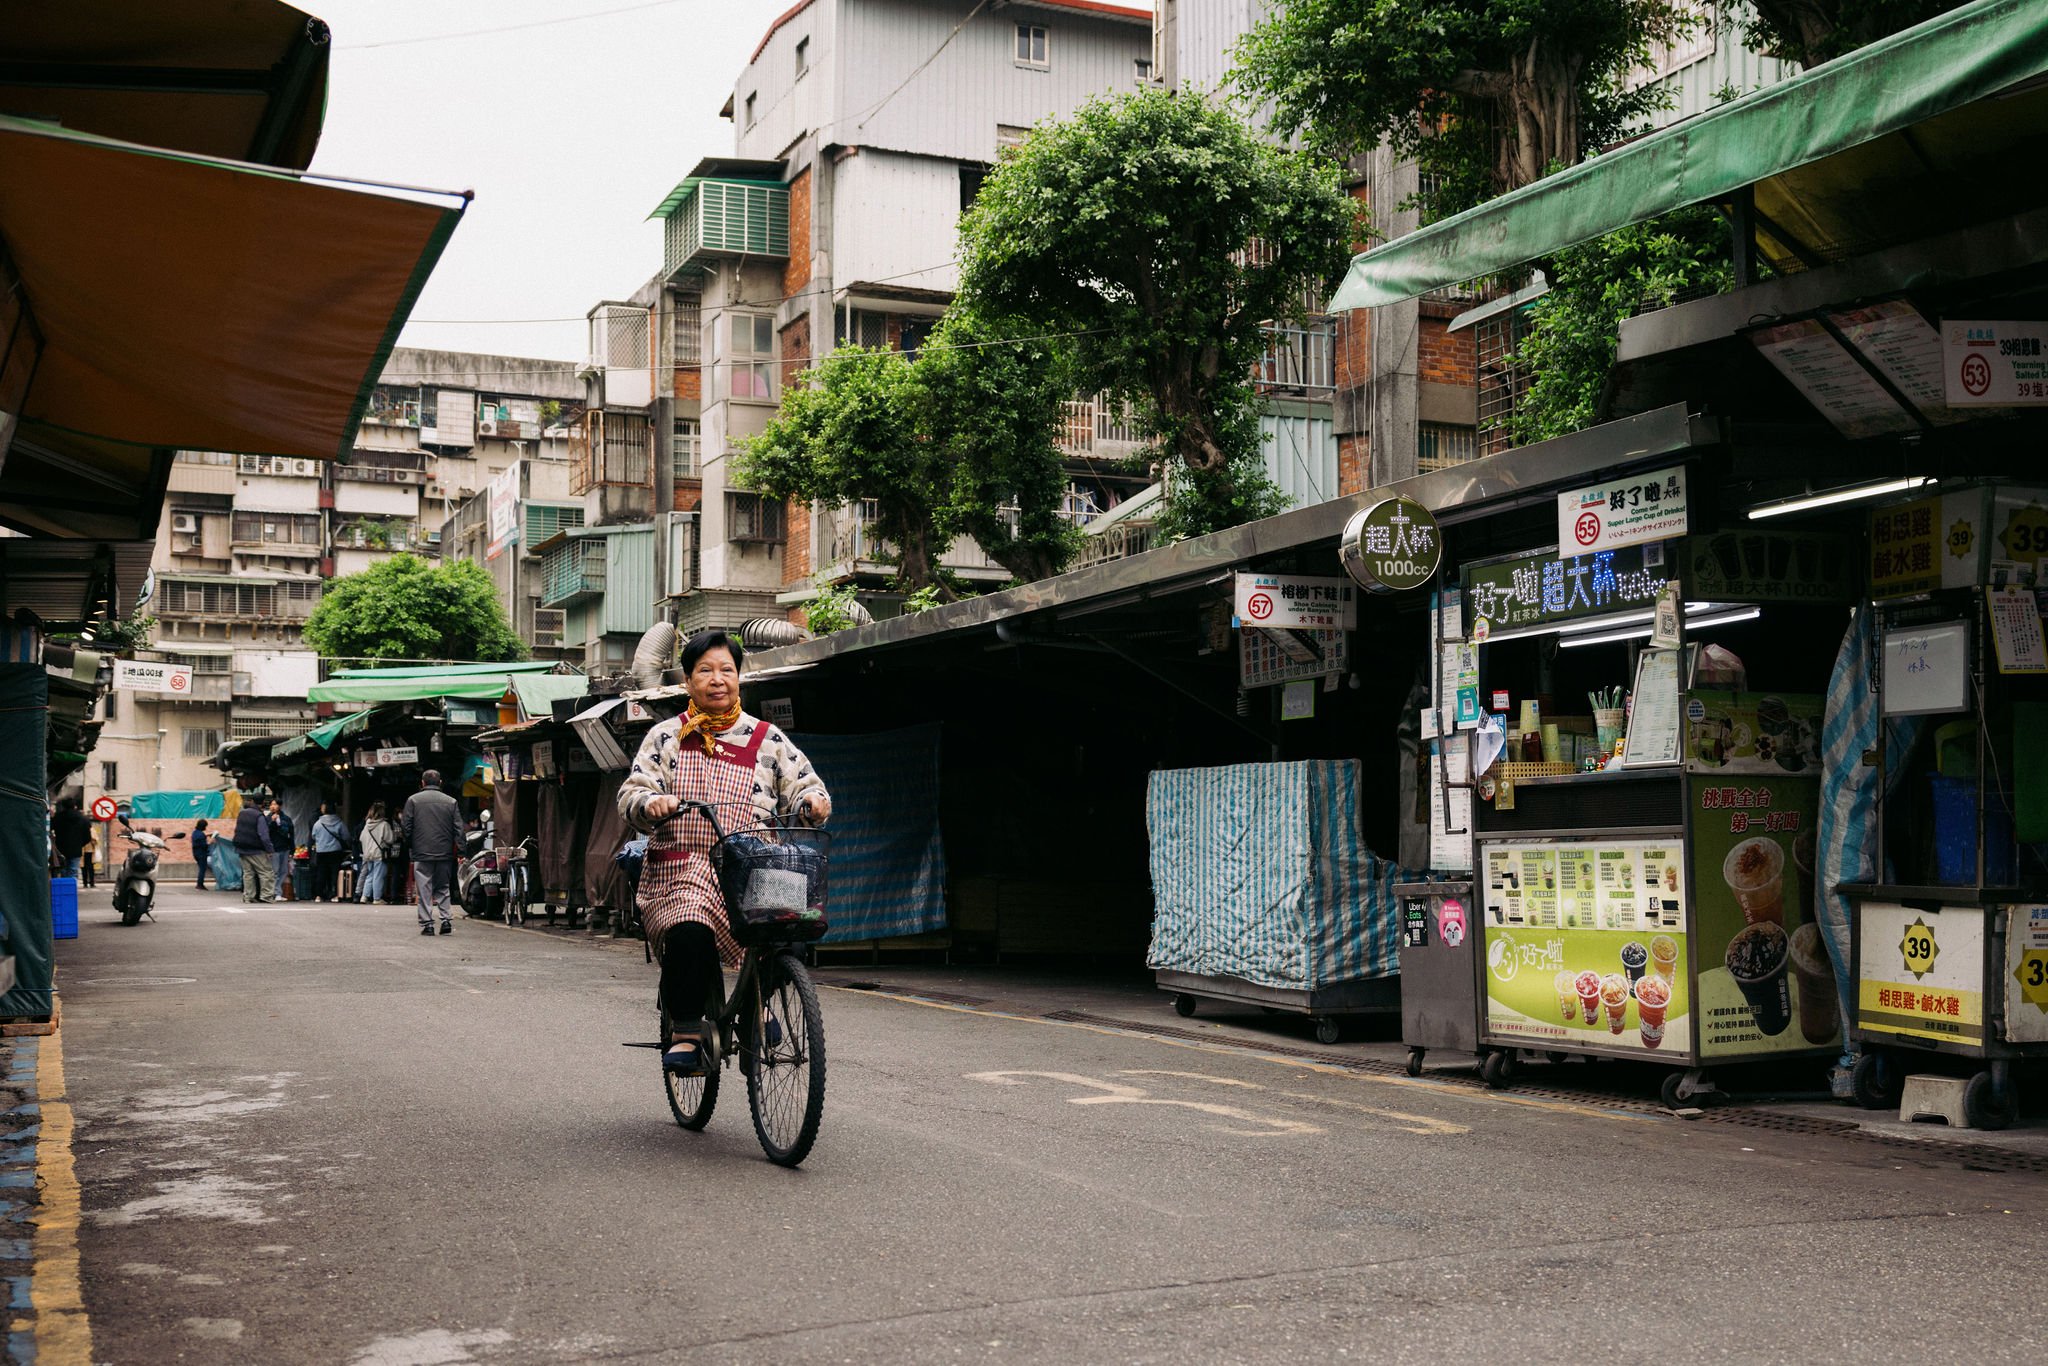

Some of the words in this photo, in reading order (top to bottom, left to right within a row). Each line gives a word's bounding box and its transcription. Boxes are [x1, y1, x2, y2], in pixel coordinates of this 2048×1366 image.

[1965, 364, 1987, 387] 53
[2012, 360, 2045, 371] Yearning
[2015, 371, 2040, 380] Salted
[1610, 482, 1661, 511] 好了啦
[1607, 519, 1625, 528] Super
[1625, 514, 1643, 524] Large
[1643, 512, 1656, 521] Cup
[1664, 506, 1686, 516] Drinks!
[1630, 506, 1648, 515] Come
[1365, 503, 1434, 558] 超大杯
[1578, 519, 1597, 539] 55
[1873, 507, 1932, 545] 相思雞
[1952, 531, 1969, 546] 39
[2013, 524, 2048, 553] 39
[1375, 560, 1429, 577] 1000cc
[1873, 541, 1932, 579] 鹹水雞
[1252, 600, 1269, 614] 57
[173, 678, 184, 687] 58
[1702, 786, 1773, 809] 挑戰全台
[1730, 810, 1801, 833] 第一好喝
[1408, 903, 1421, 911] Uber
[1409, 911, 1422, 919] Eats
[1520, 937, 1564, 971] 好了啦
[1907, 937, 1931, 960] 39
[2027, 958, 2048, 987] 3
